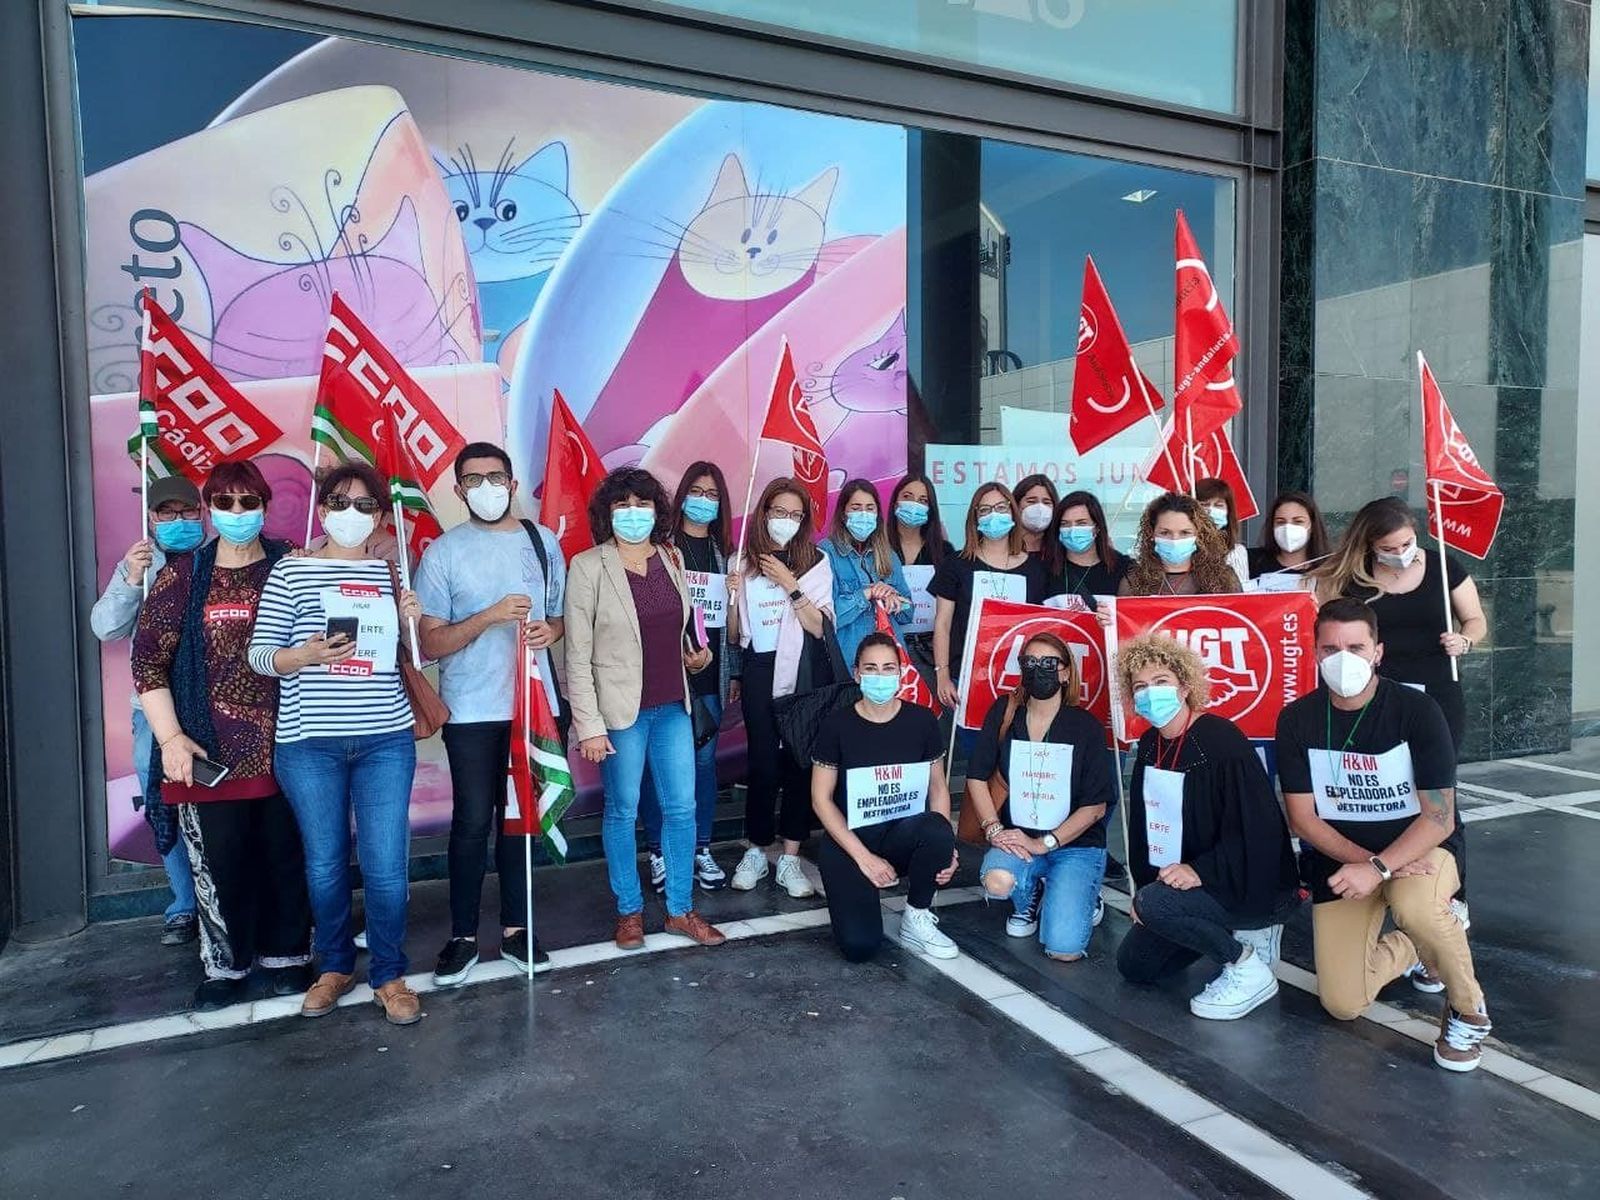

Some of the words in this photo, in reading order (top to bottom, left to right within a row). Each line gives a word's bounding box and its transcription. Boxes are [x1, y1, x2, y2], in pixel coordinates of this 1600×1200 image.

[931, 460, 1077, 485] ESTAMOS
[1096, 461, 1149, 485] JUN
[342, 588, 379, 597] CCOO
[697, 588, 706, 598] ES
[209, 608, 249, 618] CCOO
[360, 623, 385, 635] ERTE
[357, 649, 378, 659] ERE
[1160, 627, 1250, 673] GT
[1281, 613, 1303, 706] ww.ugt.es
[331, 664, 370, 676] CCOO
[1343, 753, 1378, 771] H&M
[874, 766, 902, 780] H&M
[1348, 774, 1363, 786] NO
[1365, 774, 1379, 786] ES
[878, 784, 890, 795] NO
[891, 783, 901, 794] ES
[1397, 781, 1411, 796] ES
[857, 794, 908, 809] EMPLEADORA
[908, 791, 919, 800] ES
[1337, 800, 1406, 813] DESTRUCTORA
[1149, 822, 1171, 834] ERTE
